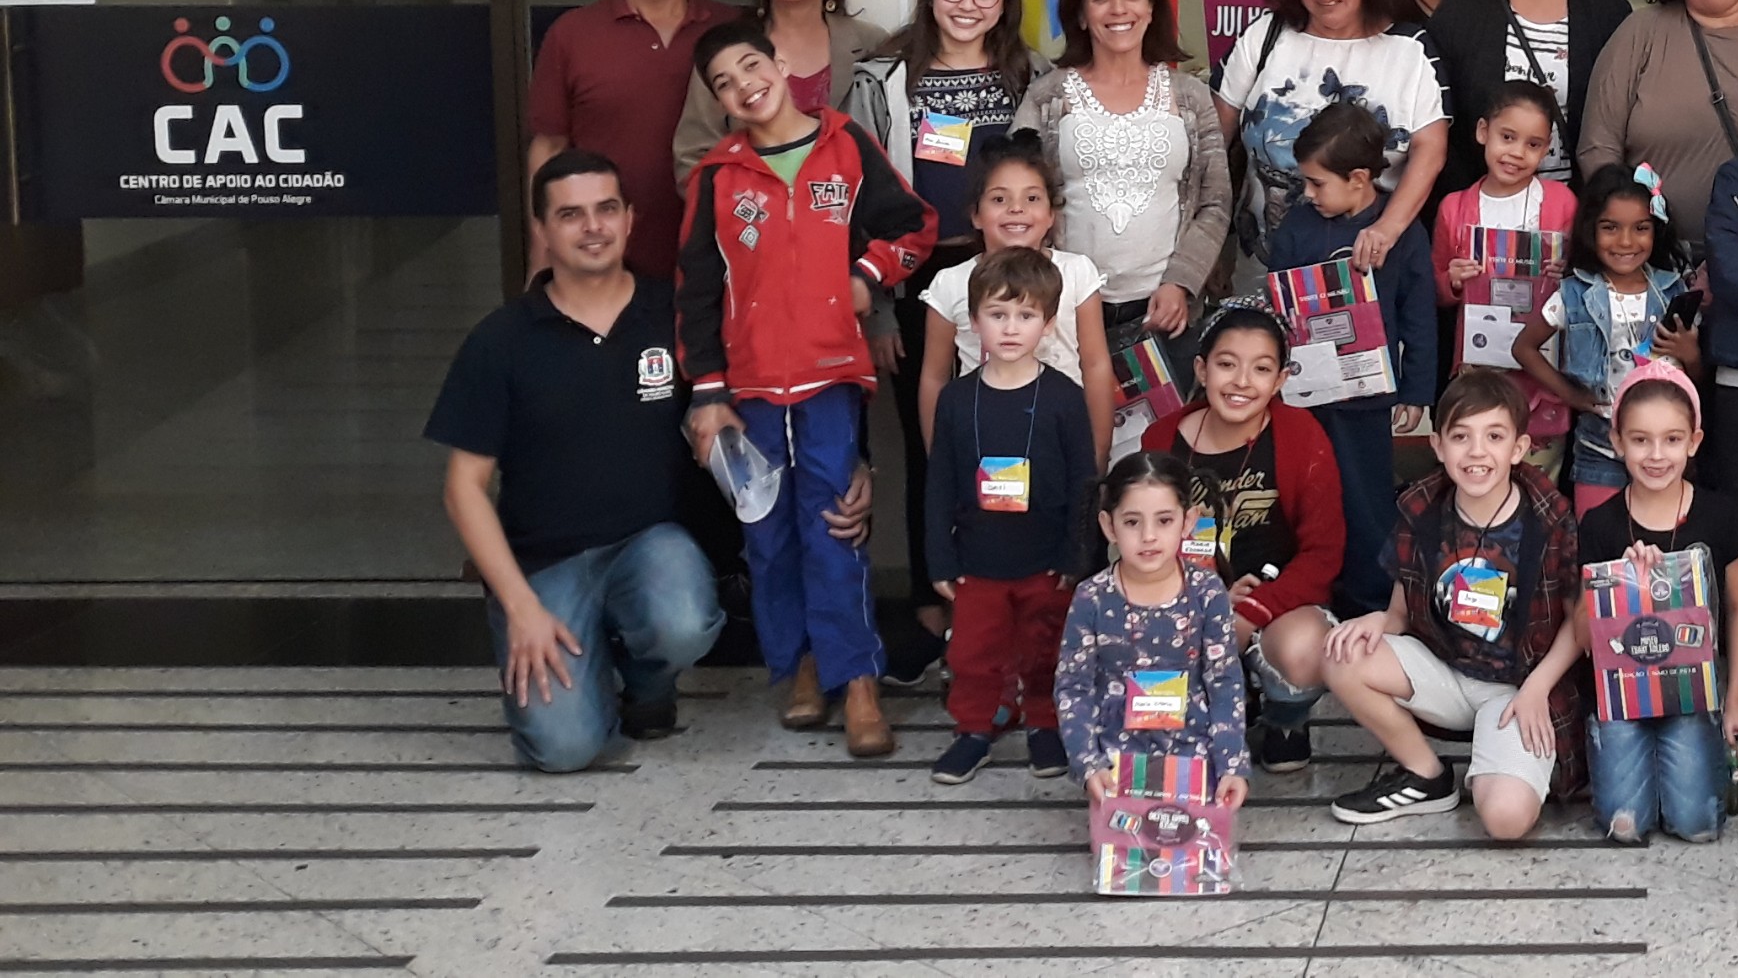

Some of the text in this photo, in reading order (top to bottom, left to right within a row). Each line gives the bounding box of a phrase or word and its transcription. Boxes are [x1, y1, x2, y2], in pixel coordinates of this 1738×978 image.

[153, 104, 306, 164] CAC
[119, 171, 345, 189] CENTRO DE APOIO AO CIDADÃO
[154, 194, 312, 206] Câmara Municipal de Pouso Alegre
